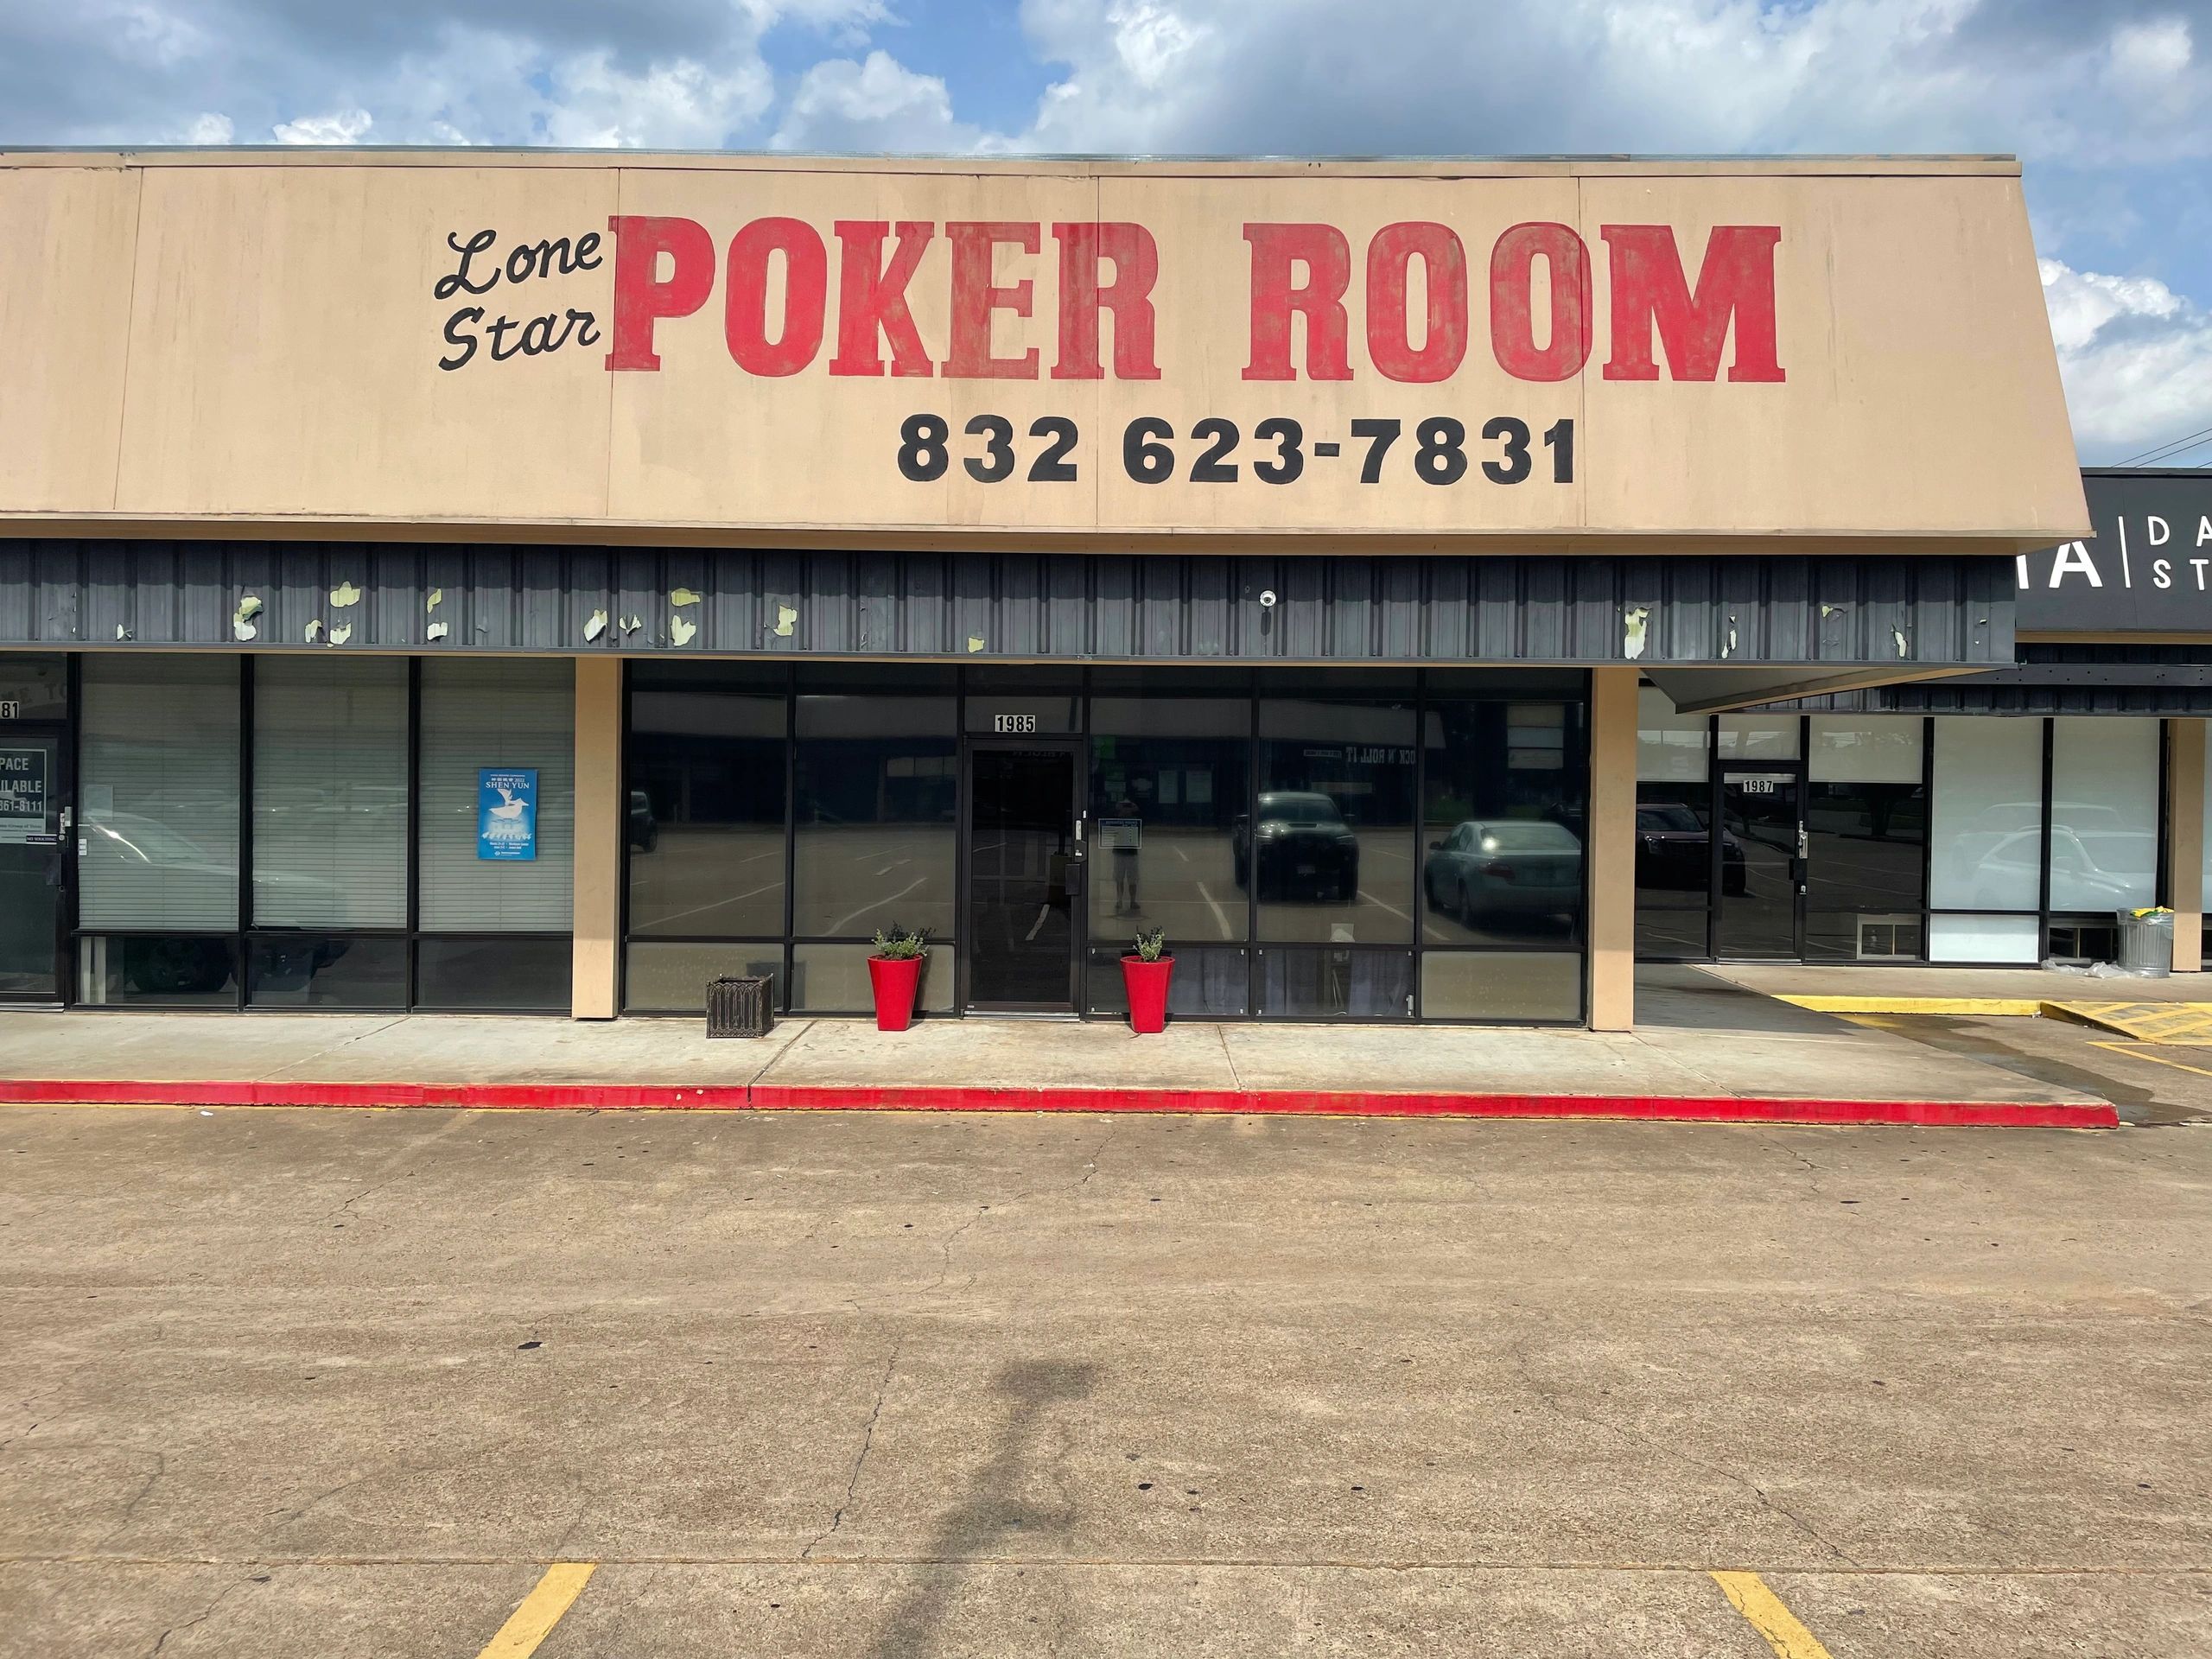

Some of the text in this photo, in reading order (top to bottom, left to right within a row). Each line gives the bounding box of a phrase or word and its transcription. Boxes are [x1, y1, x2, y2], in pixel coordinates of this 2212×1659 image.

[434, 229, 603, 300] Lone
[605, 215, 1786, 384] POKER ROOM
[438, 306, 601, 372] Star
[898, 414, 1573, 485] 832 623-7831
[2152, 558, 2209, 590] ST
[2, 702, 18, 718] 81
[997, 715, 1034, 732] 1985
[1745, 780, 1772, 792] 1987
